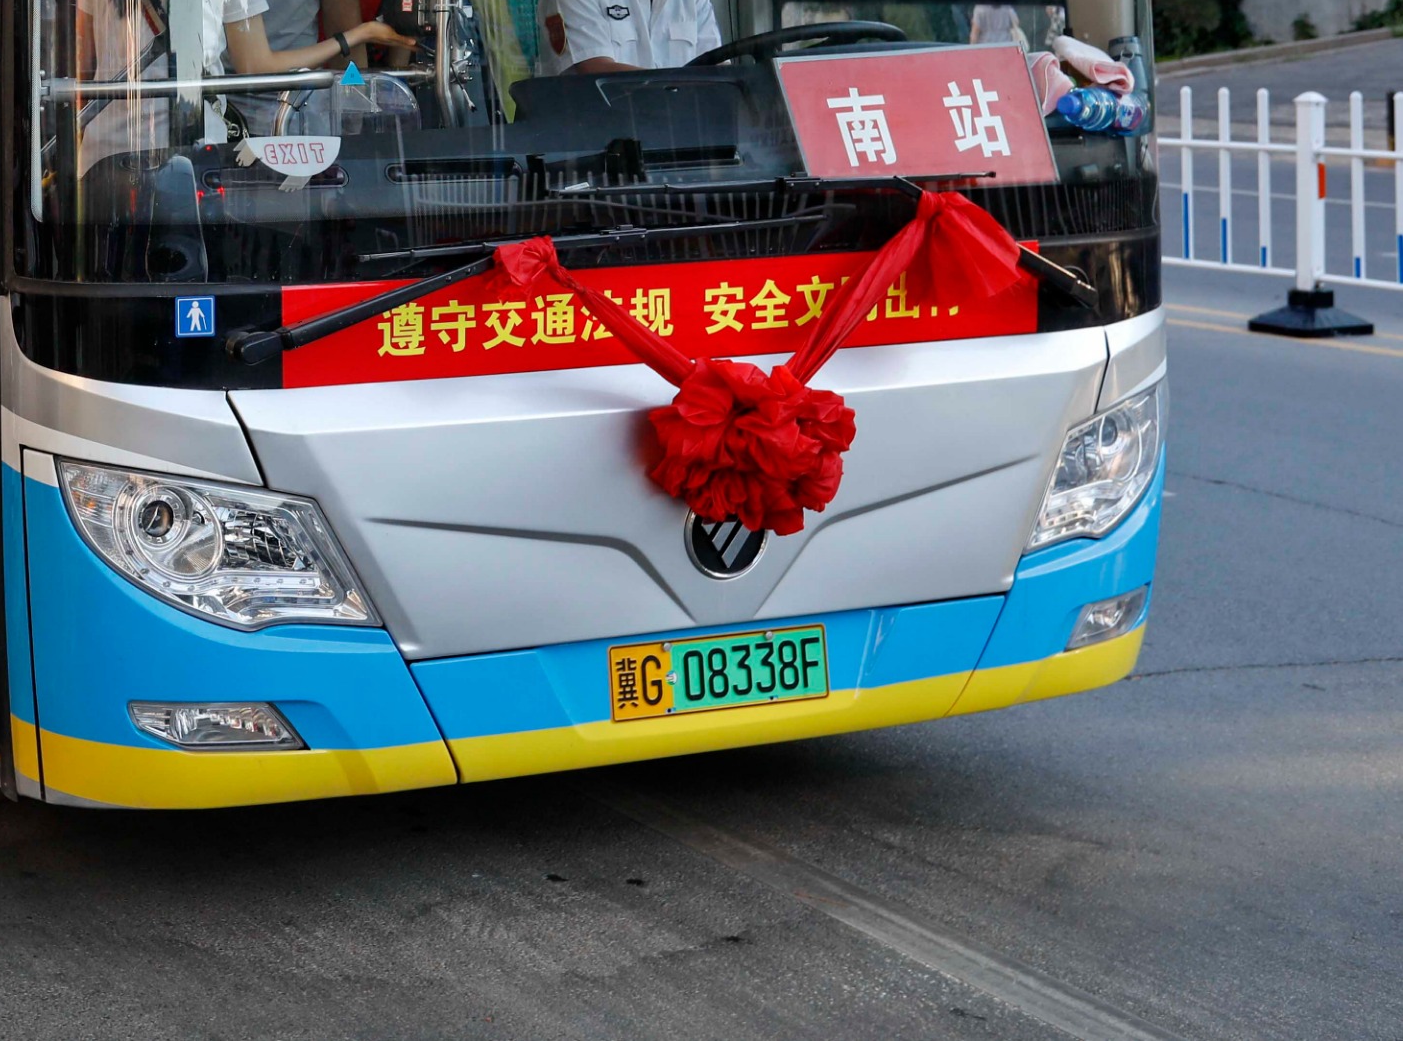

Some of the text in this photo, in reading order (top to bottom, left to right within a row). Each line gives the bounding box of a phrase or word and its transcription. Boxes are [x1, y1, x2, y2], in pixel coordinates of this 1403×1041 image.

[263, 142, 325, 166] EXIT
[703, 271, 959, 335] 安全文出
